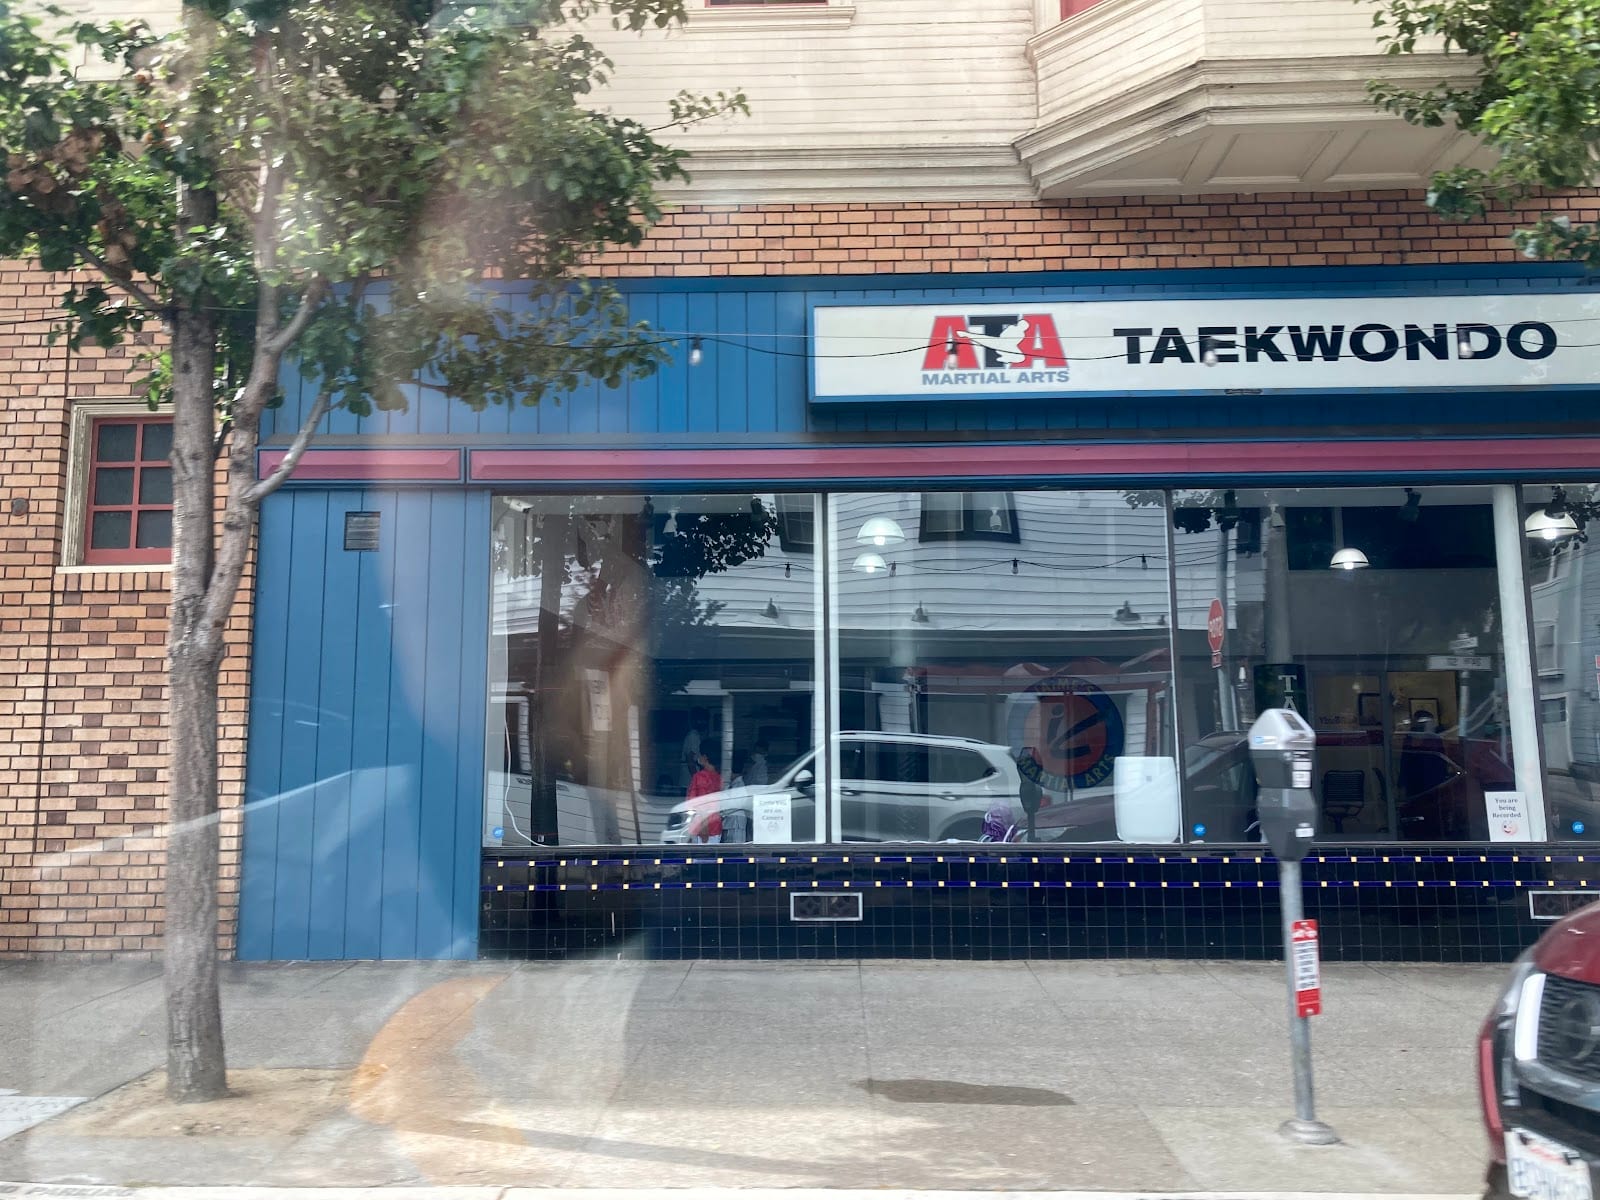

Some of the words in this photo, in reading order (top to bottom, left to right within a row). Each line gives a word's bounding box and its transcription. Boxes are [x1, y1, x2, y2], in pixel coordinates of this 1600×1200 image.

[922, 312, 1070, 370] ATA
[1112, 321, 1558, 365] TAEKWONDO
[922, 372, 1011, 386] MARTIAL
[1016, 370, 1070, 384] ARTS
[1085, 754, 1115, 786] ARTS
